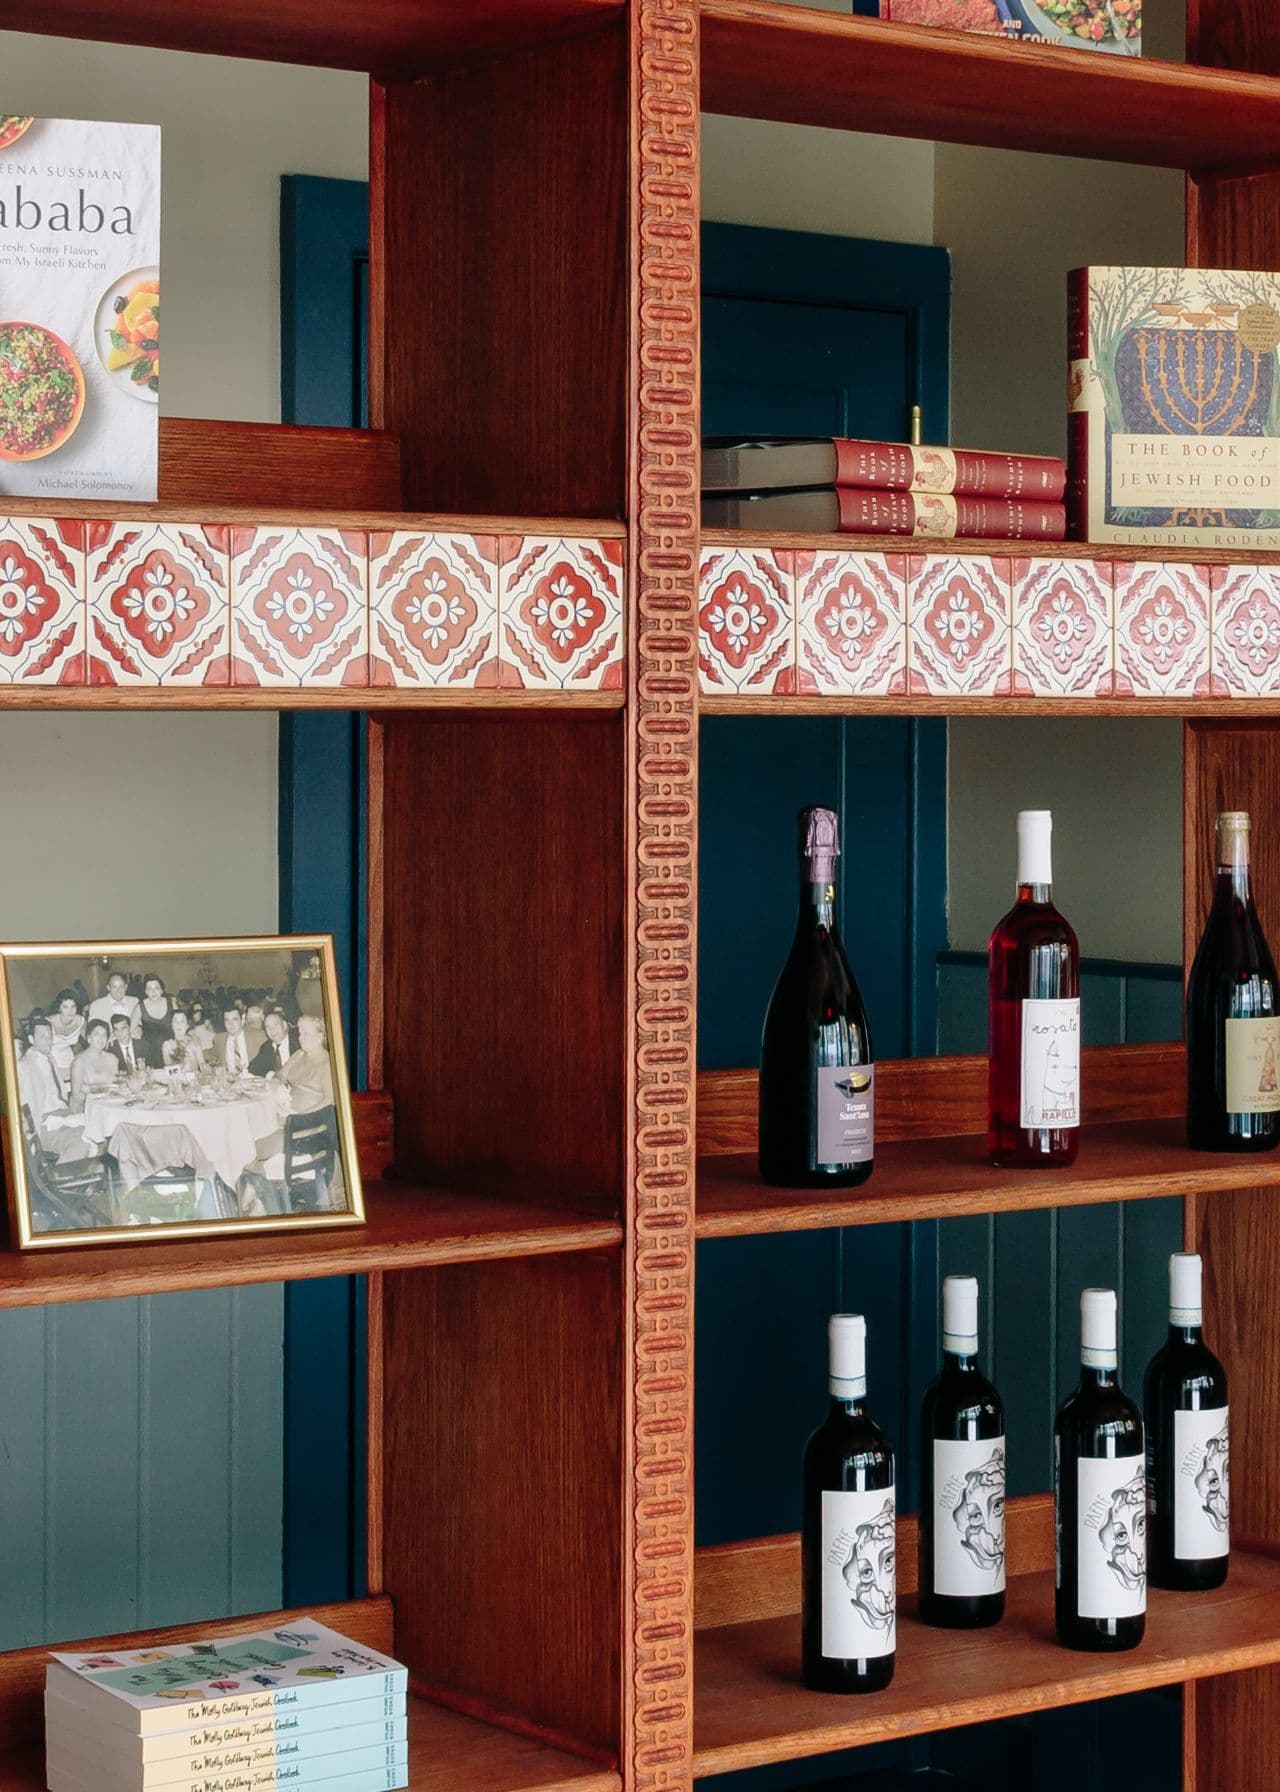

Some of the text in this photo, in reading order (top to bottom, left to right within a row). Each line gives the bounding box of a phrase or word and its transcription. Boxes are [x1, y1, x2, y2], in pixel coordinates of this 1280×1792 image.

[1003, 20, 1021, 29] AND
[47, 166, 122, 180] SUSSMAN
[30, 243, 60, 256] Sunny
[63, 244, 98, 256] Flavors
[15, 256, 31, 268] My
[35, 256, 64, 267] Israeli
[69, 257, 106, 270] Kitchen
[1128, 443, 1267, 461] THE BOOK of
[39, 479, 78, 488] Michael
[1120, 473, 1271, 488] JEWISH FOOD
[1113, 533, 1278, 545] CLAUDIA RODEN
[939, 1474, 965, 1509] DAFNE
[827, 1529, 851, 1566] DAFNE
[187, 1708, 199, 1719] The
[201, 1704, 220, 1720] Molly
[222, 1702, 251, 1716] Goldberg
[251, 1696, 273, 1710] Jewish
[190, 1727, 252, 1746] The Molly Goldberg
[190, 1760, 202, 1772] The
